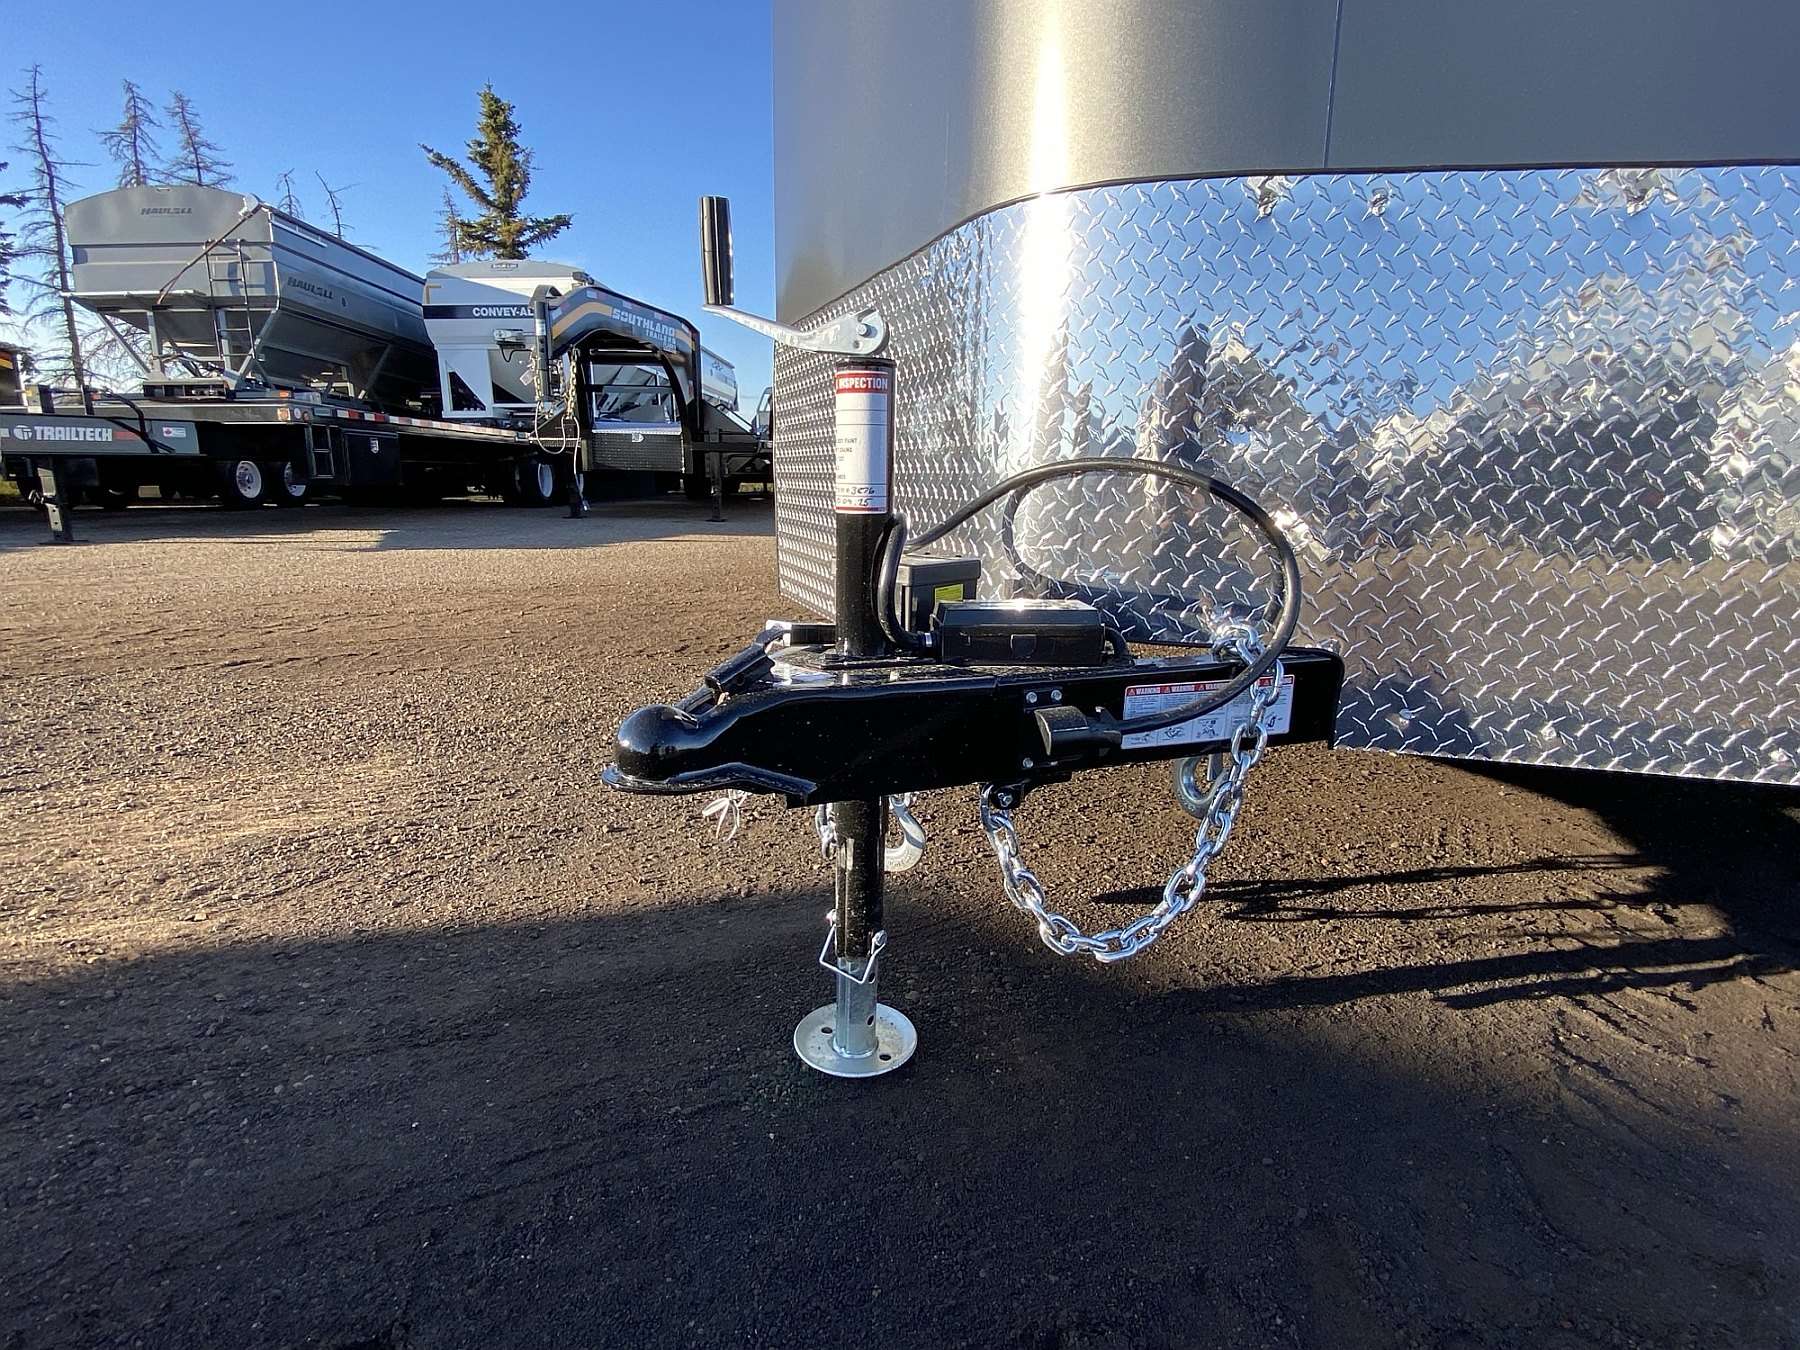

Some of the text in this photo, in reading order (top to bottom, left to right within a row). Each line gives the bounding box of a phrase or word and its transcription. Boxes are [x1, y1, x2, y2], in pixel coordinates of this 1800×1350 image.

[472, 307, 535, 317] CONVEY-AL
[612, 308, 675, 337] SOUTHLAND
[34, 426, 113, 442] TRAILTECH
[1136, 687, 1161, 695] WARNING
[1171, 684, 1195, 693] WARNING
